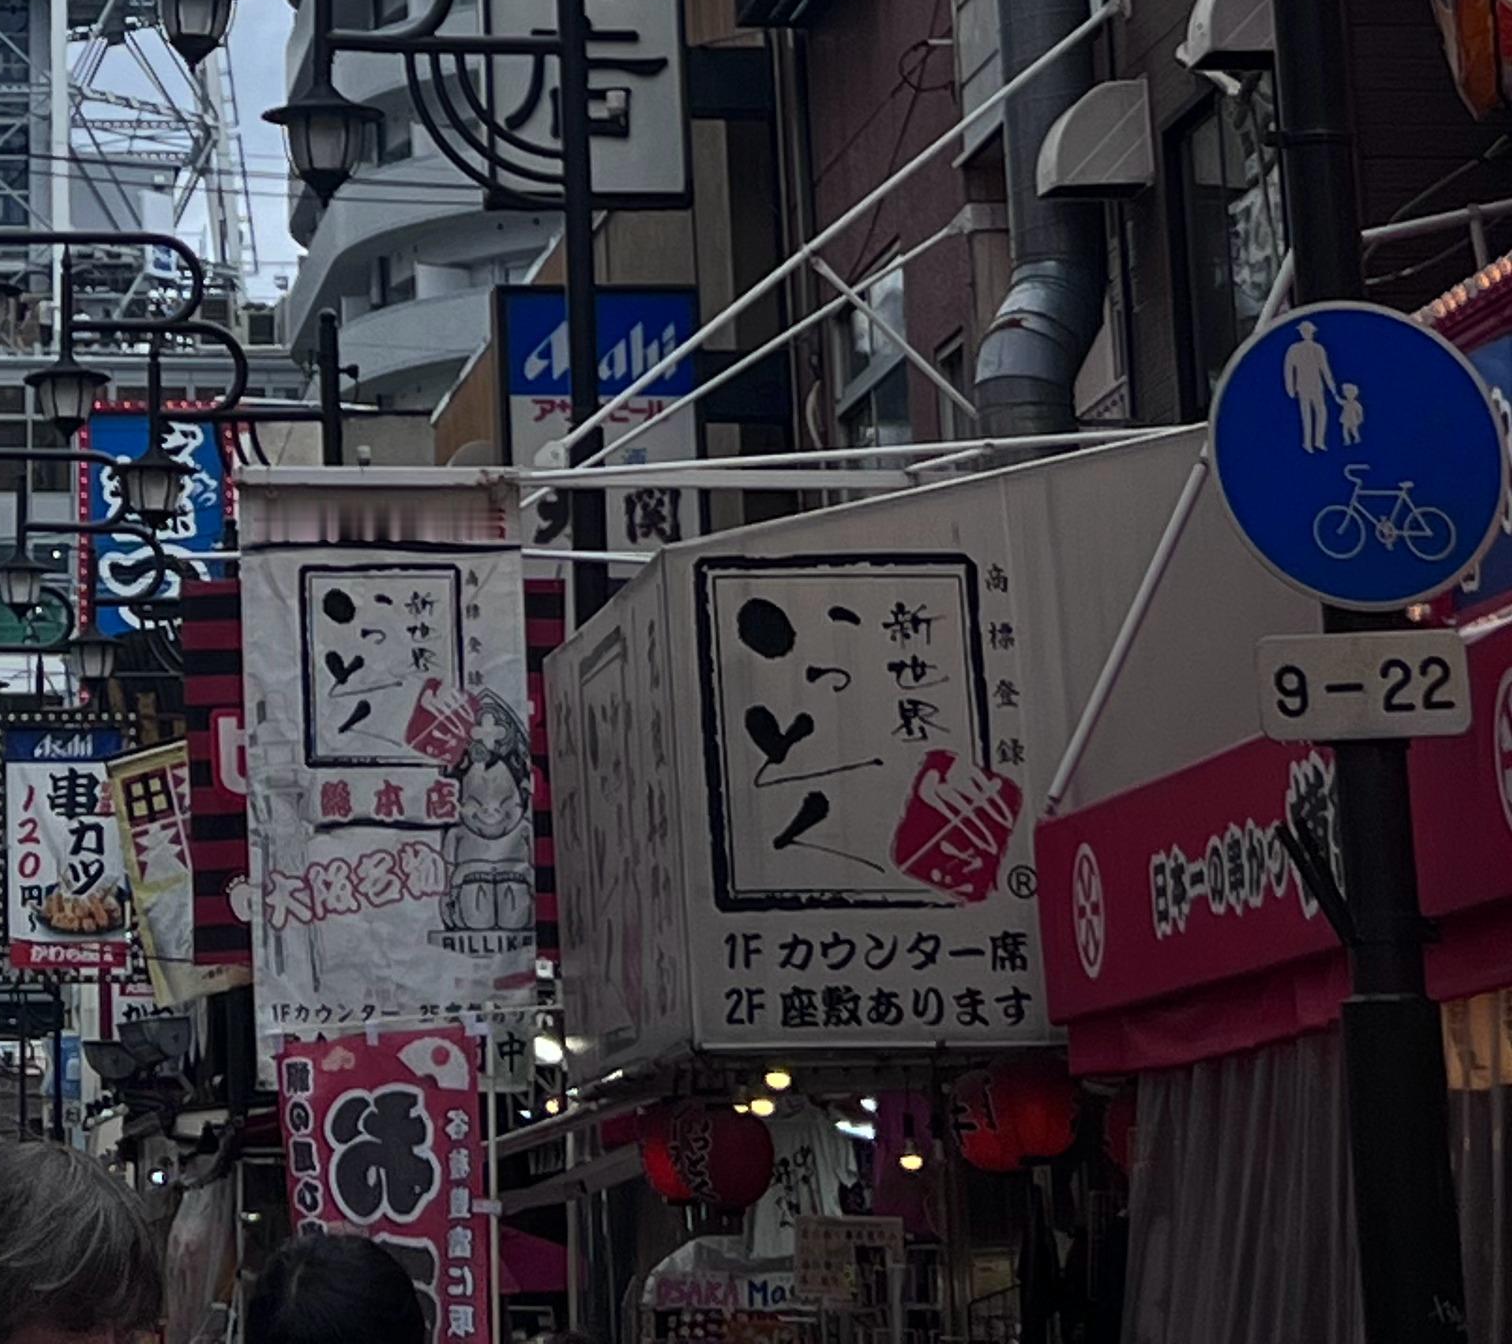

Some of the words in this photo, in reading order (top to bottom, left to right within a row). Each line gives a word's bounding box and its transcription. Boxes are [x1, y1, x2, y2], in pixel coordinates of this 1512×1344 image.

[524, 320, 677, 381] Aahi
[882, 601, 952, 743] 新世界
[986, 564, 1025, 766] 商標登録
[47, 767, 105, 895] 串カツ
[266, 841, 448, 930] 大阪名物
[725, 932, 762, 970] 1F
[779, 931, 1029, 973] カウンター席
[725, 987, 766, 1025] 2F
[779, 986, 1033, 1029] 座敷あります
